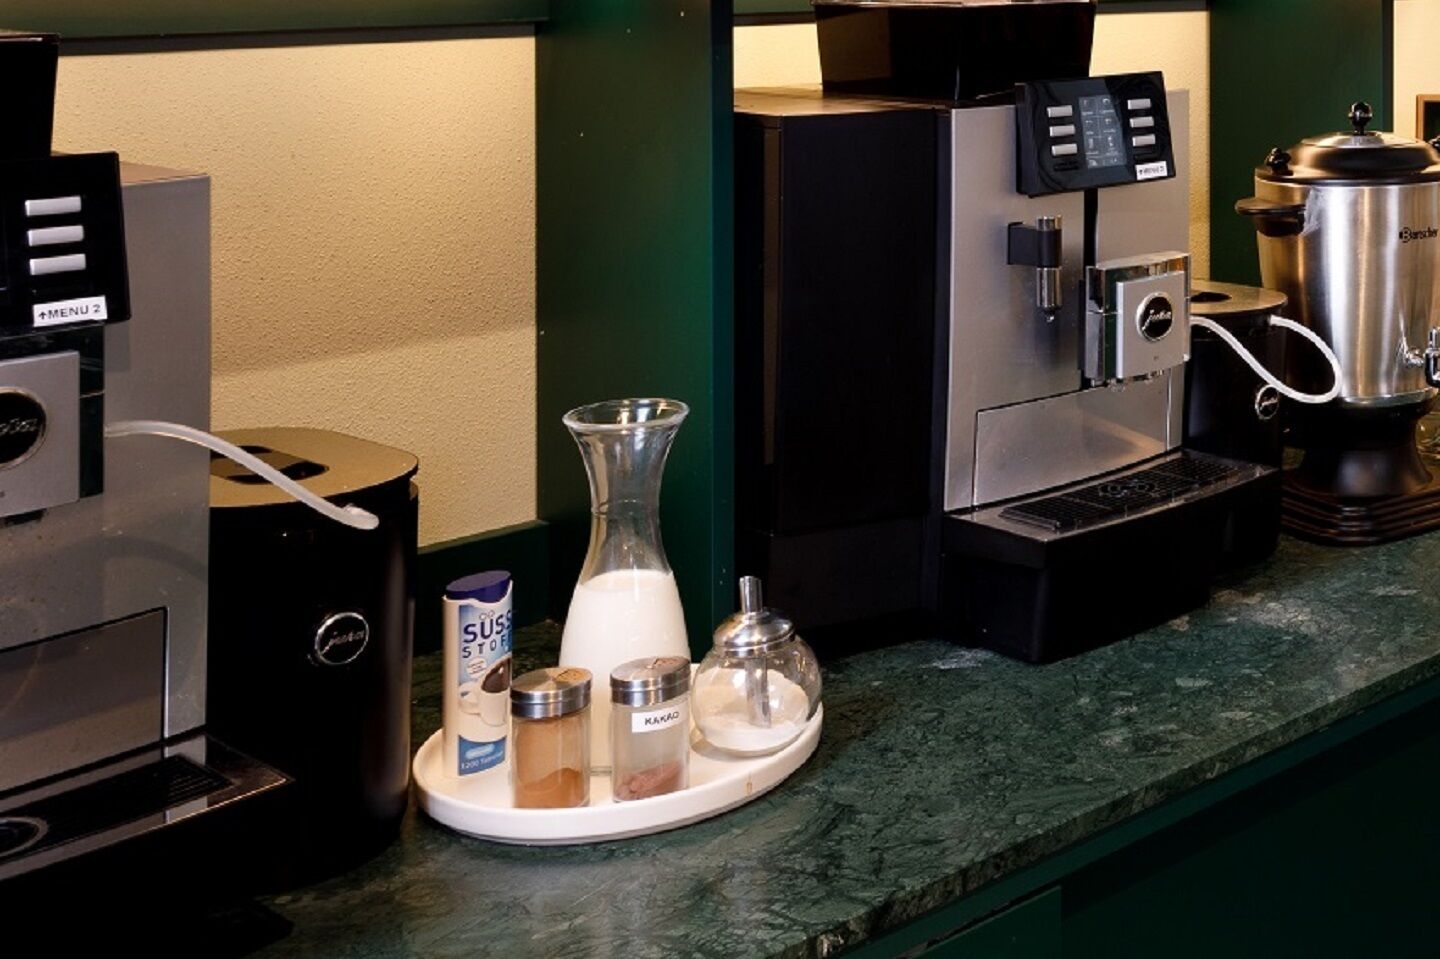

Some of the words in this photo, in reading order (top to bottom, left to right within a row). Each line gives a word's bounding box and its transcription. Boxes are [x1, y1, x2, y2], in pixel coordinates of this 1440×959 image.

[48, 304, 89, 319] MENU
[92, 303, 101, 314] 2
[644, 711, 680, 726] KAKAO
